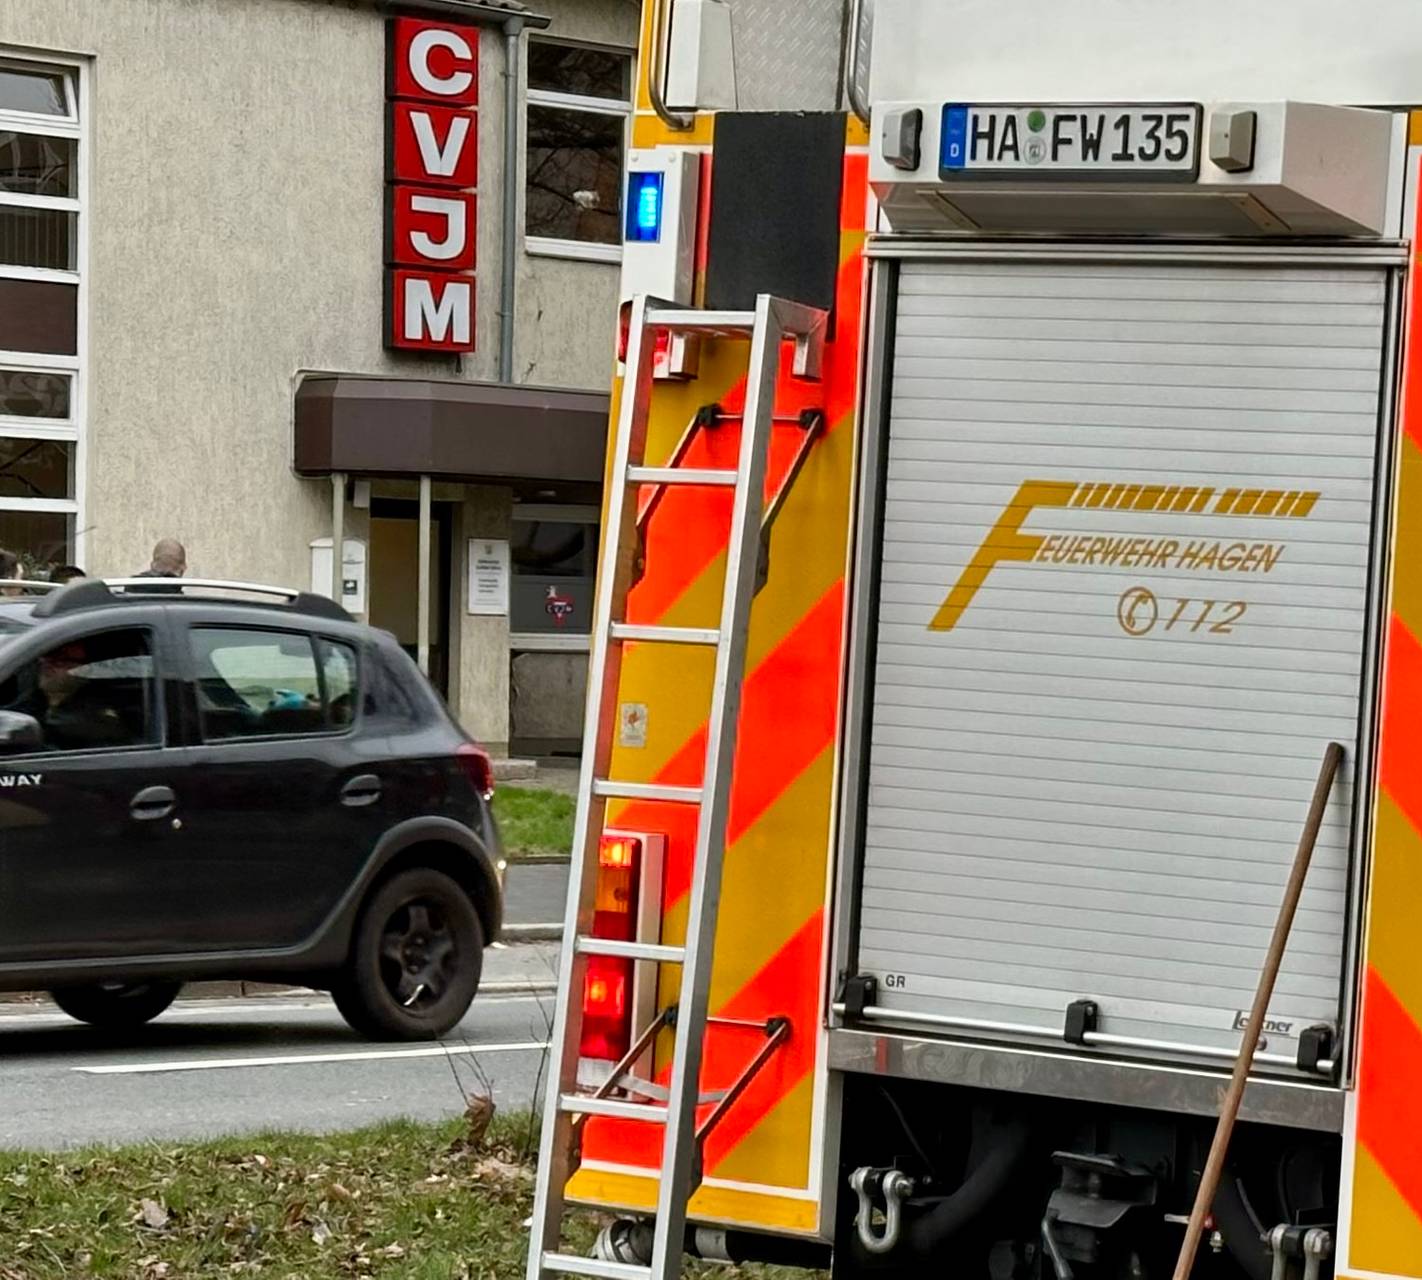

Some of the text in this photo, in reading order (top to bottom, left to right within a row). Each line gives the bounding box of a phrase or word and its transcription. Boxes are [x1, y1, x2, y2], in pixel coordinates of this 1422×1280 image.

[970, 114, 1020, 161] HA
[404, 29, 473, 343] CVJM
[1177, 541, 1286, 573] HAGEN
[1164, 599, 1248, 634] 112
[0, 774, 42, 787] WAY
[885, 974, 906, 988] GR
[1232, 1010, 1293, 1037] Lener
